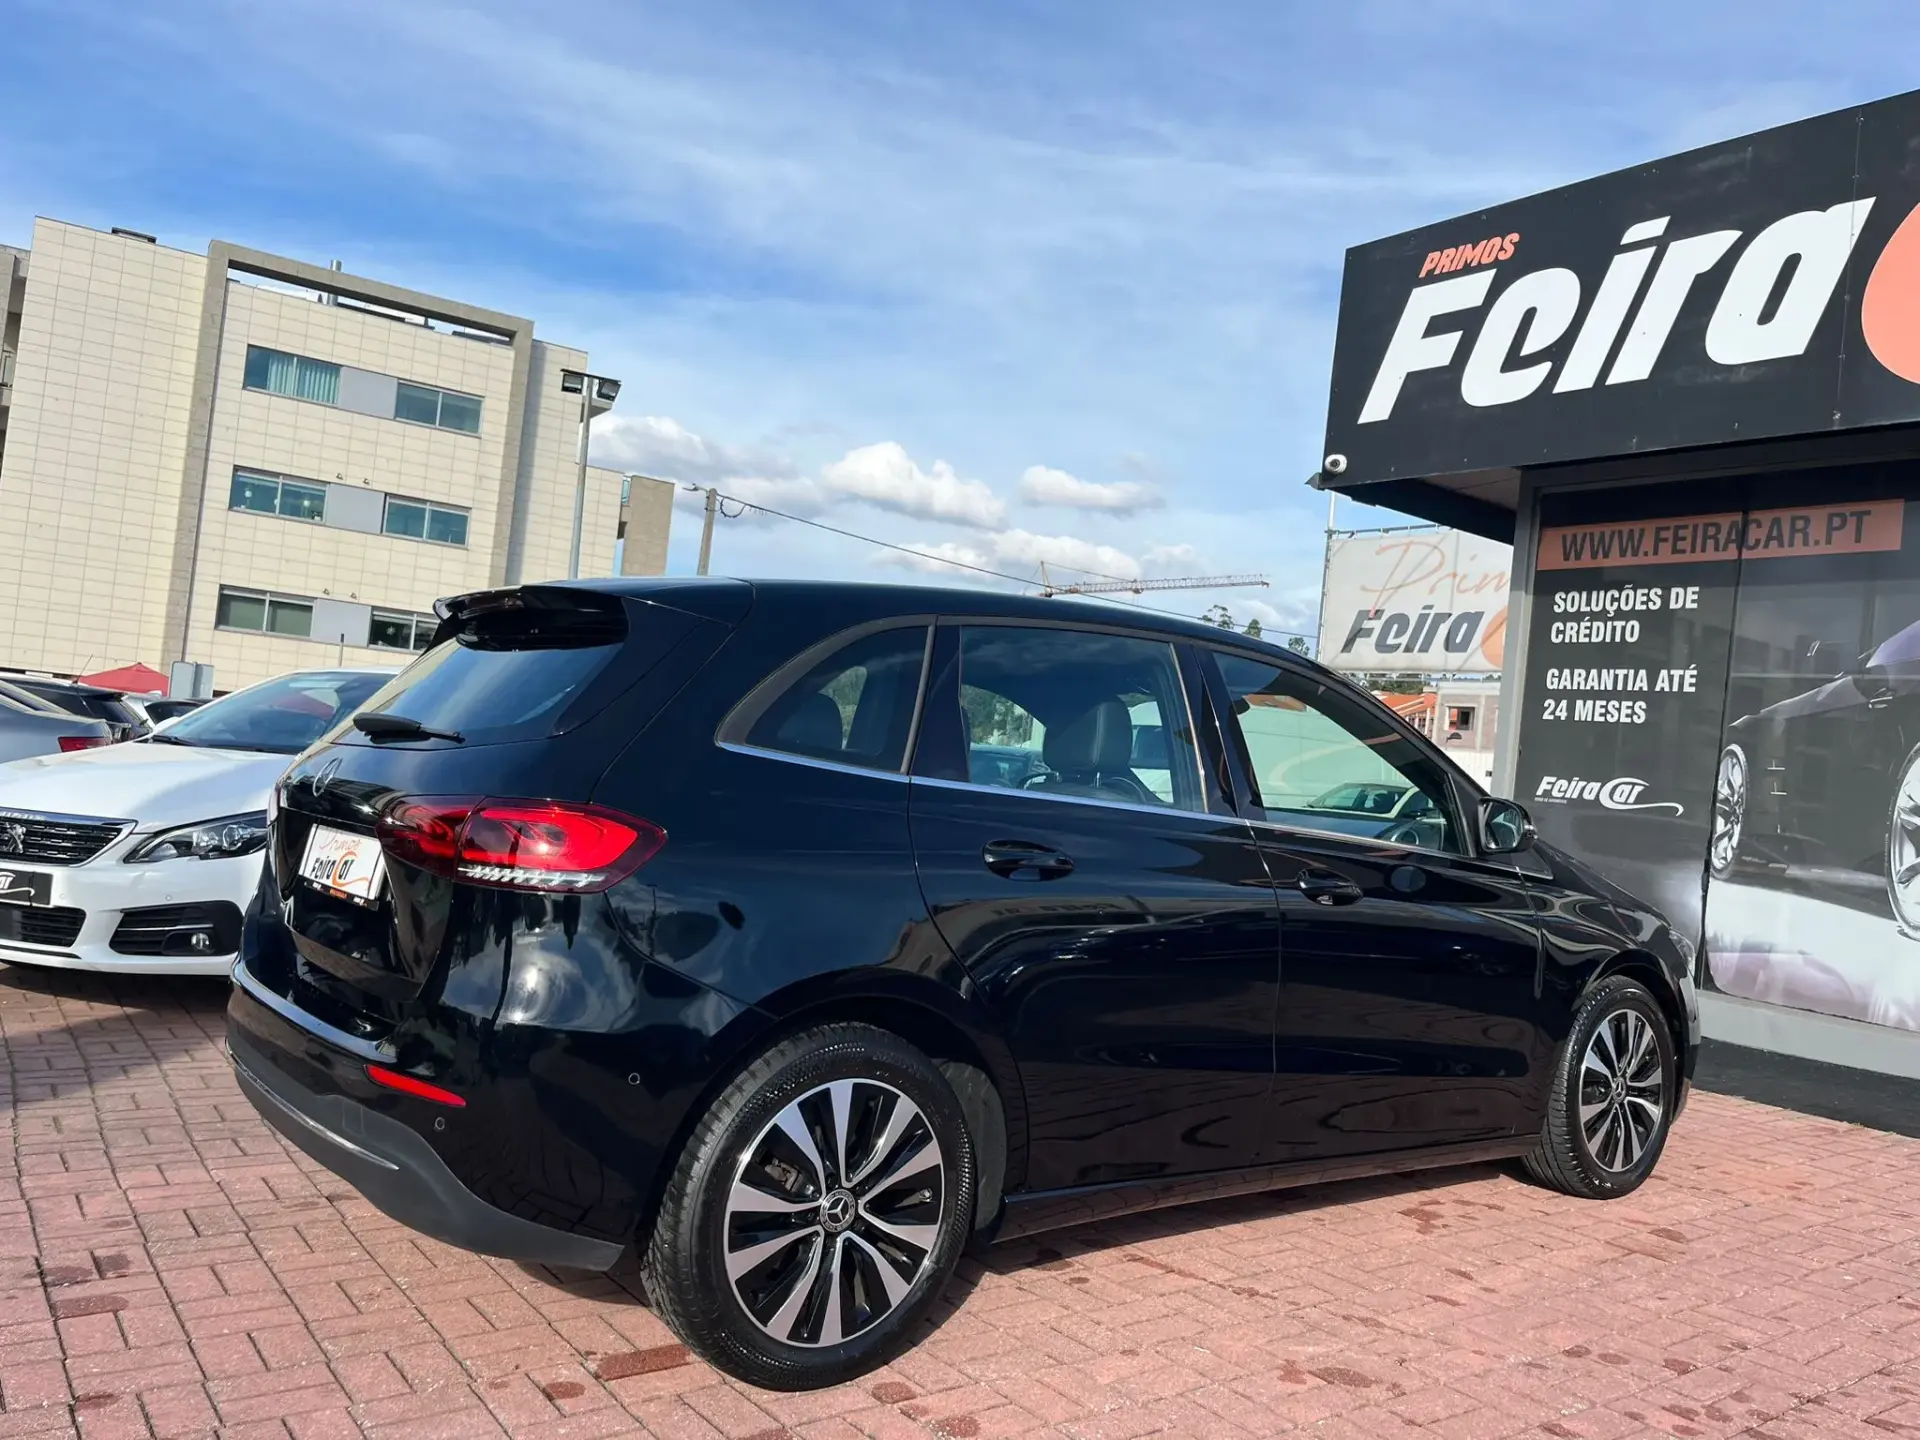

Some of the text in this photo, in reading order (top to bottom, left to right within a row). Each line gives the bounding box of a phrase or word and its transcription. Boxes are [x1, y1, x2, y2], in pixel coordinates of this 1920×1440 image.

[1419, 233, 1520, 278] PRIMOS
[1357, 196, 1920, 425] Feira
[1561, 510, 1872, 562] WWW.FEIRACAR.PT
[1553, 584, 1699, 616] SOLUÇÕES DE
[1340, 604, 1508, 668] Feira
[1550, 617, 1641, 643] CRÉDITO
[1546, 664, 1698, 693] GARANTIA ATÉ
[1542, 699, 1647, 724] 24 MESES
